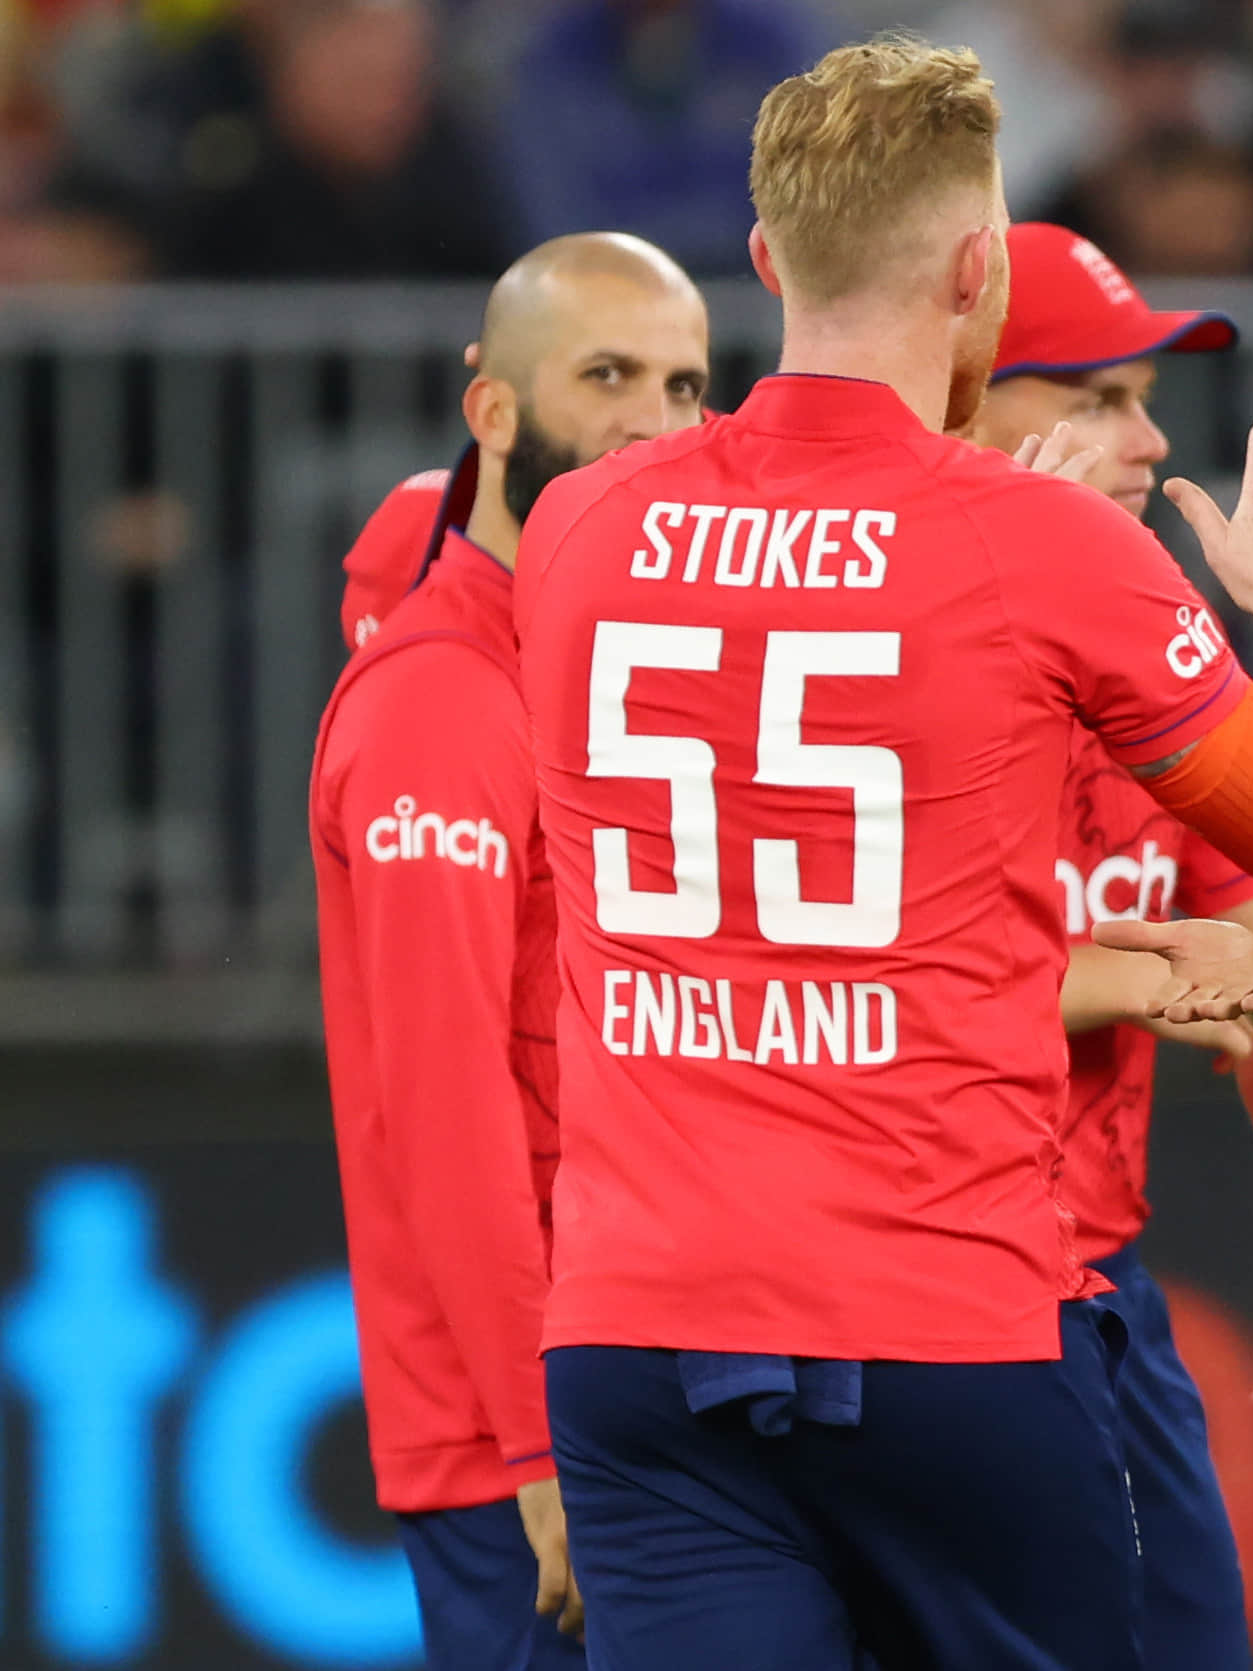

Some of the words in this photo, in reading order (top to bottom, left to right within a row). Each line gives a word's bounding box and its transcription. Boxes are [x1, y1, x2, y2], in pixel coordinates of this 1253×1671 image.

[630, 501, 897, 589] STOKES
[586, 620, 904, 948] 55
[366, 795, 508, 879] cinch
[601, 970, 898, 1065] ENGLAND
